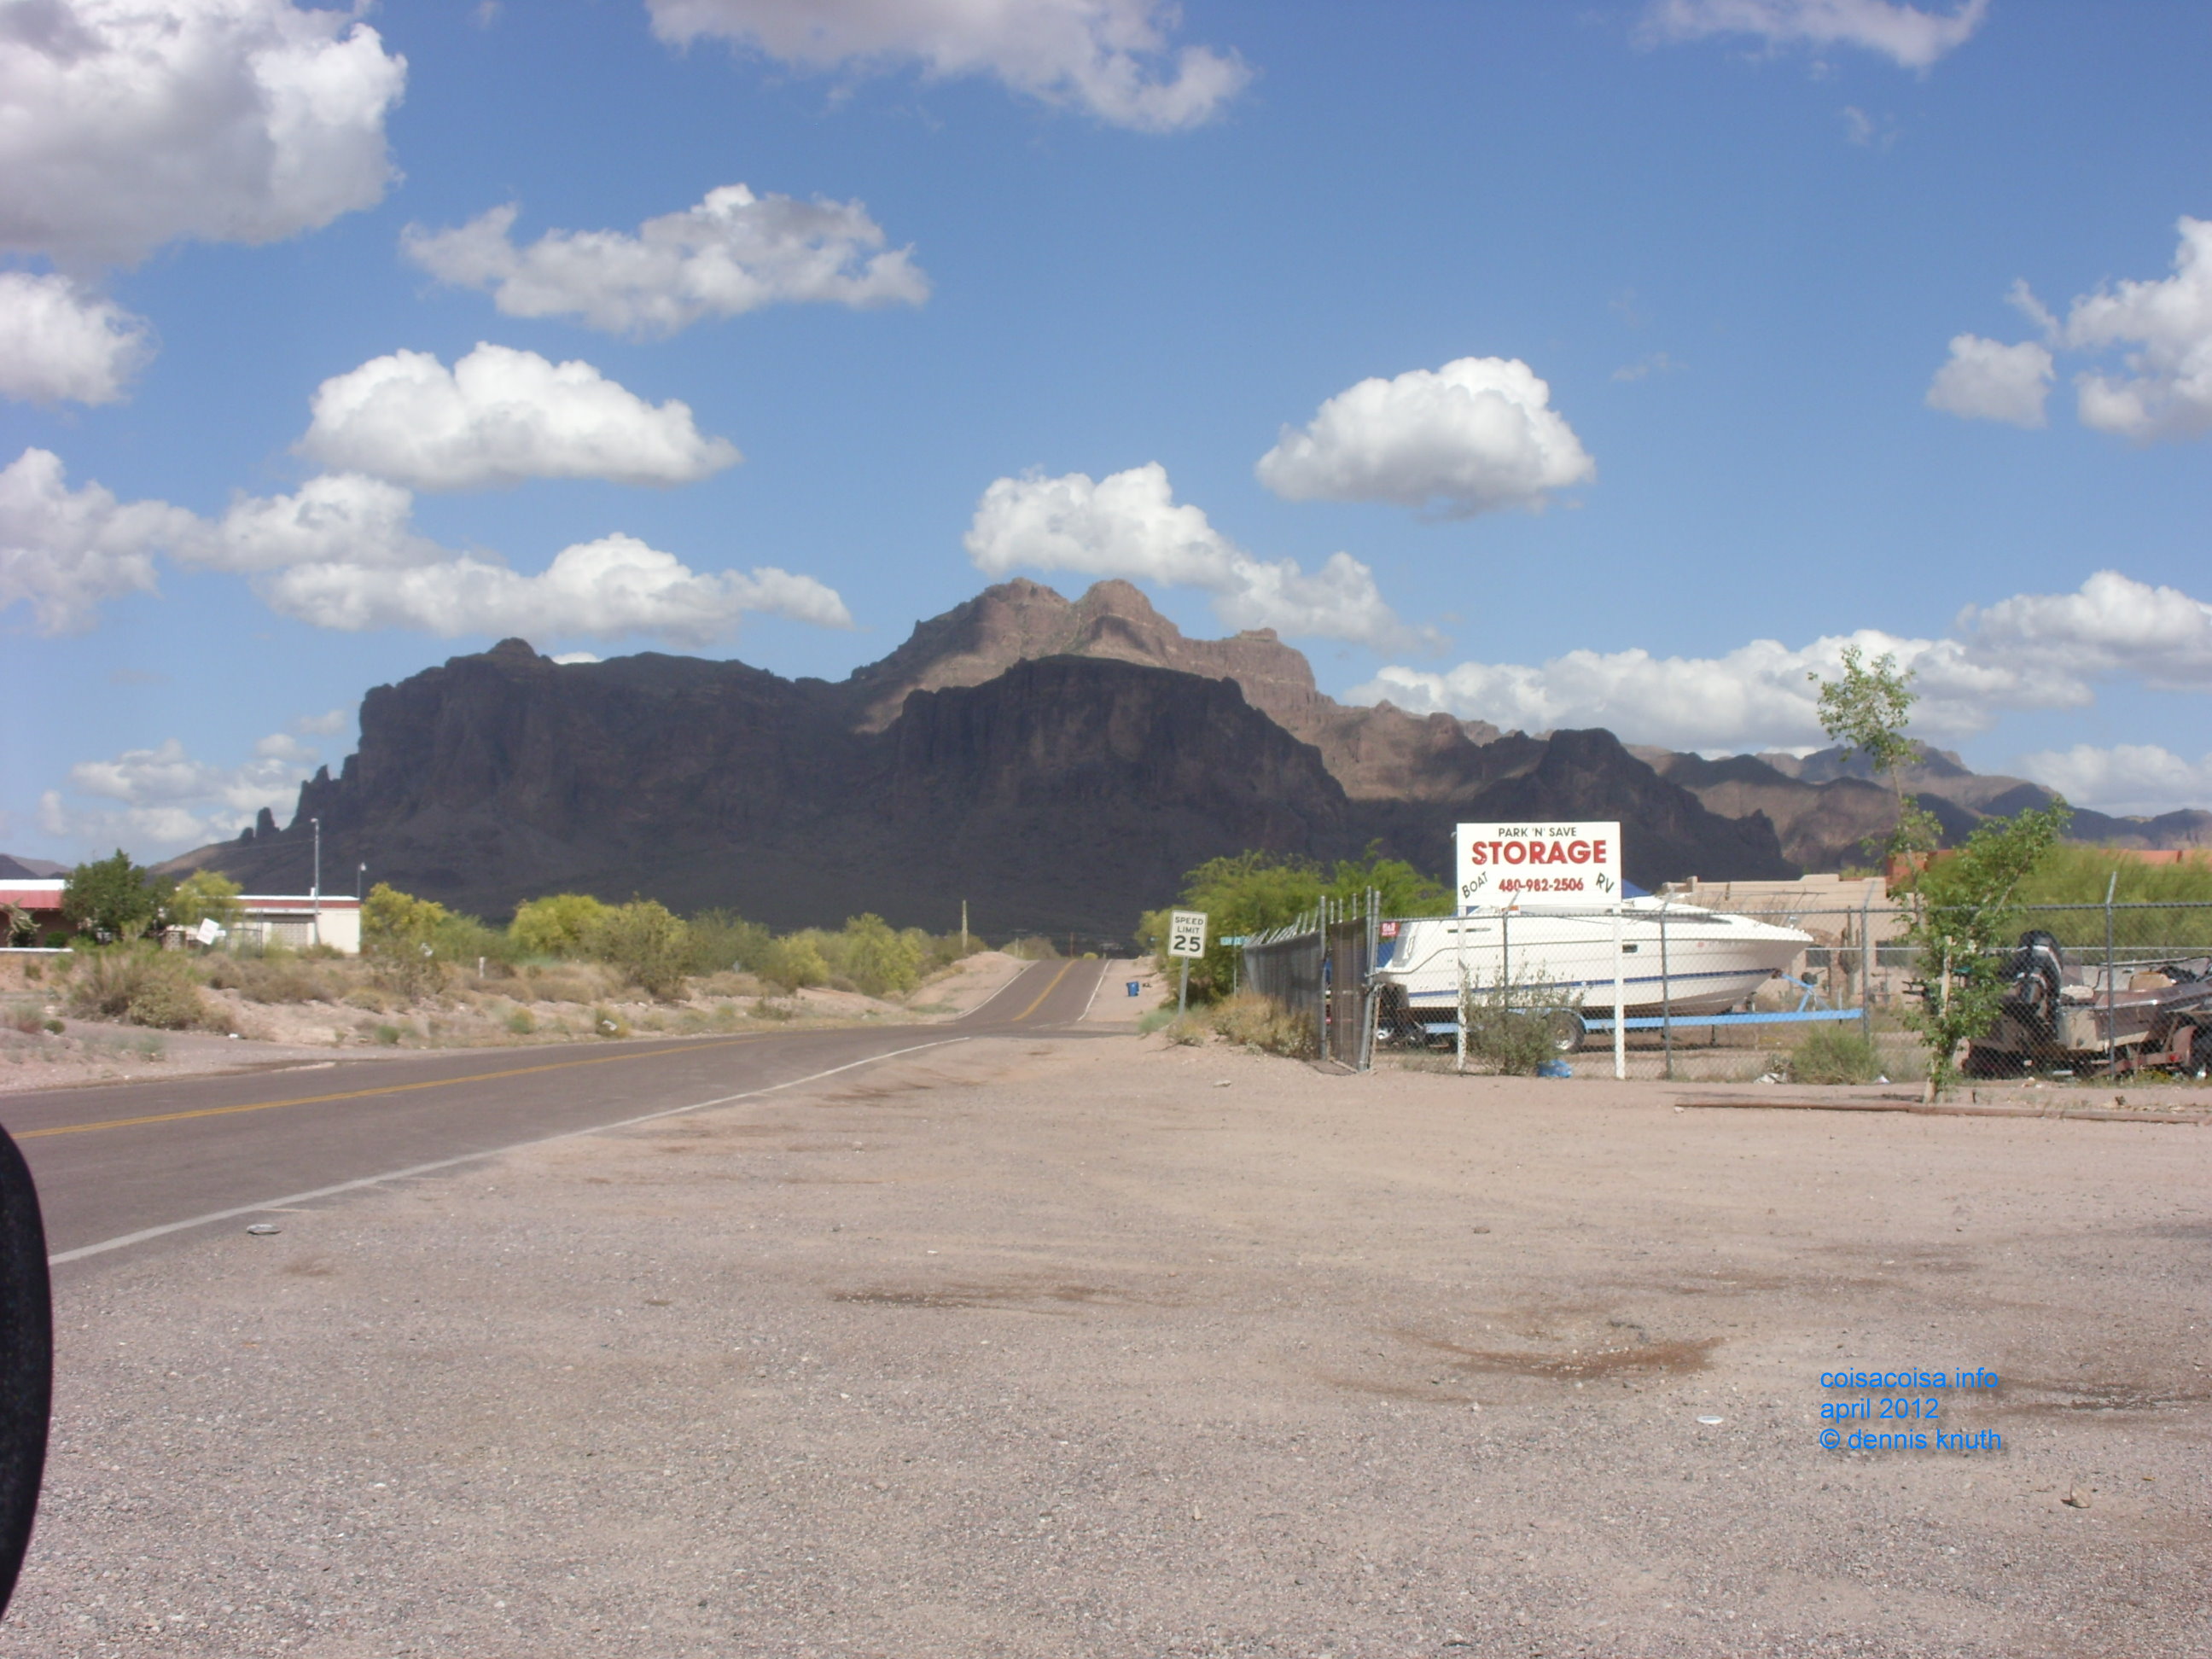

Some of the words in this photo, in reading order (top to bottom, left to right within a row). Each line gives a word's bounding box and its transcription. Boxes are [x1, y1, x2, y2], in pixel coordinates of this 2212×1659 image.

[1499, 827, 1528, 837] PARK
[1549, 827, 1577, 837] SAVE
[1471, 840, 1607, 865] STORAGE
[1462, 870, 1488, 899] BOAT
[1499, 878, 1584, 892] 480-982-2506
[1596, 872, 1615, 894] RV
[1175, 917, 1203, 925] SPEED
[1177, 926, 1200, 934] LIMIT
[1173, 935, 1201, 952] 25
